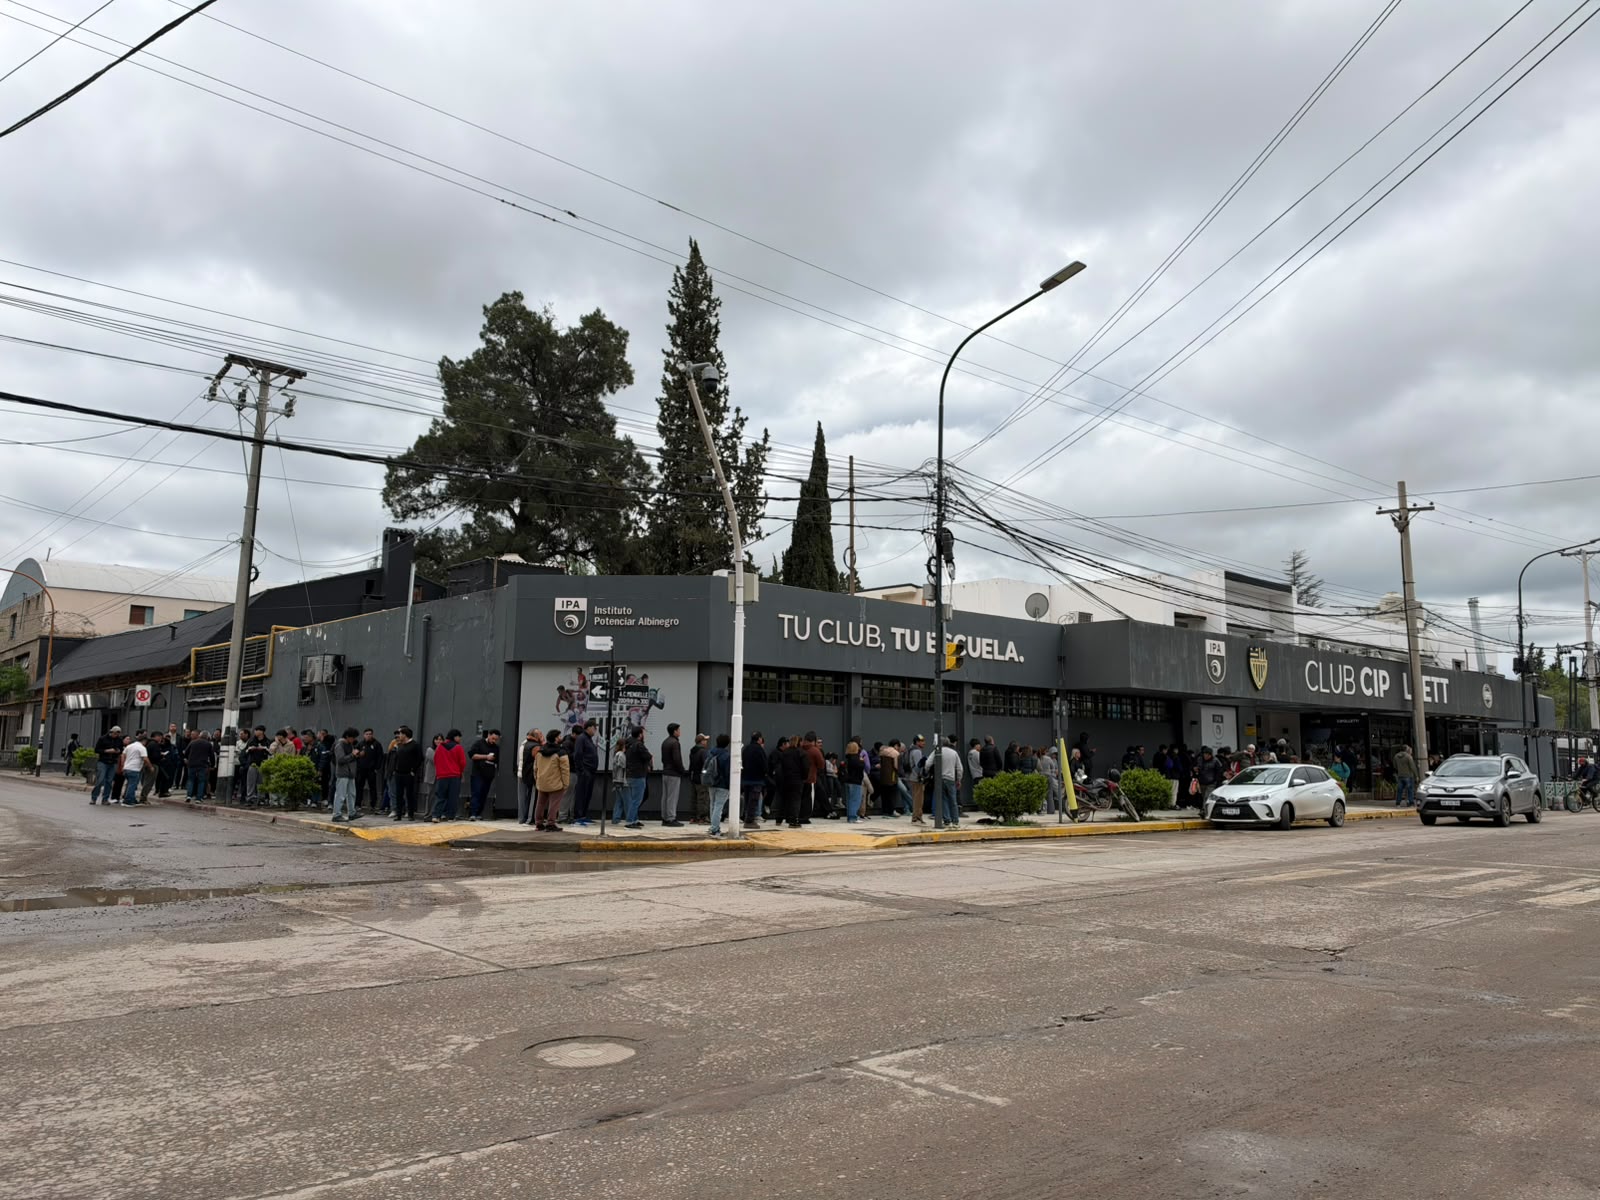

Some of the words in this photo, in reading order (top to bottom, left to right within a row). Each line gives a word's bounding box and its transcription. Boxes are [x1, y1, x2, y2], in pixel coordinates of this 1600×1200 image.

[561, 600, 580, 609] IPA
[594, 606, 633, 615] Instituto
[594, 617, 636, 626] Potenciar
[638, 617, 680, 628] Albinegro
[778, 613, 811, 641] TU
[818, 619, 886, 652] CLUB,
[890, 627, 921, 652] TU
[926, 631, 1025, 664] ECUELA.
[1209, 642, 1222, 654] IPA
[1304, 660, 1356, 695] CLUB
